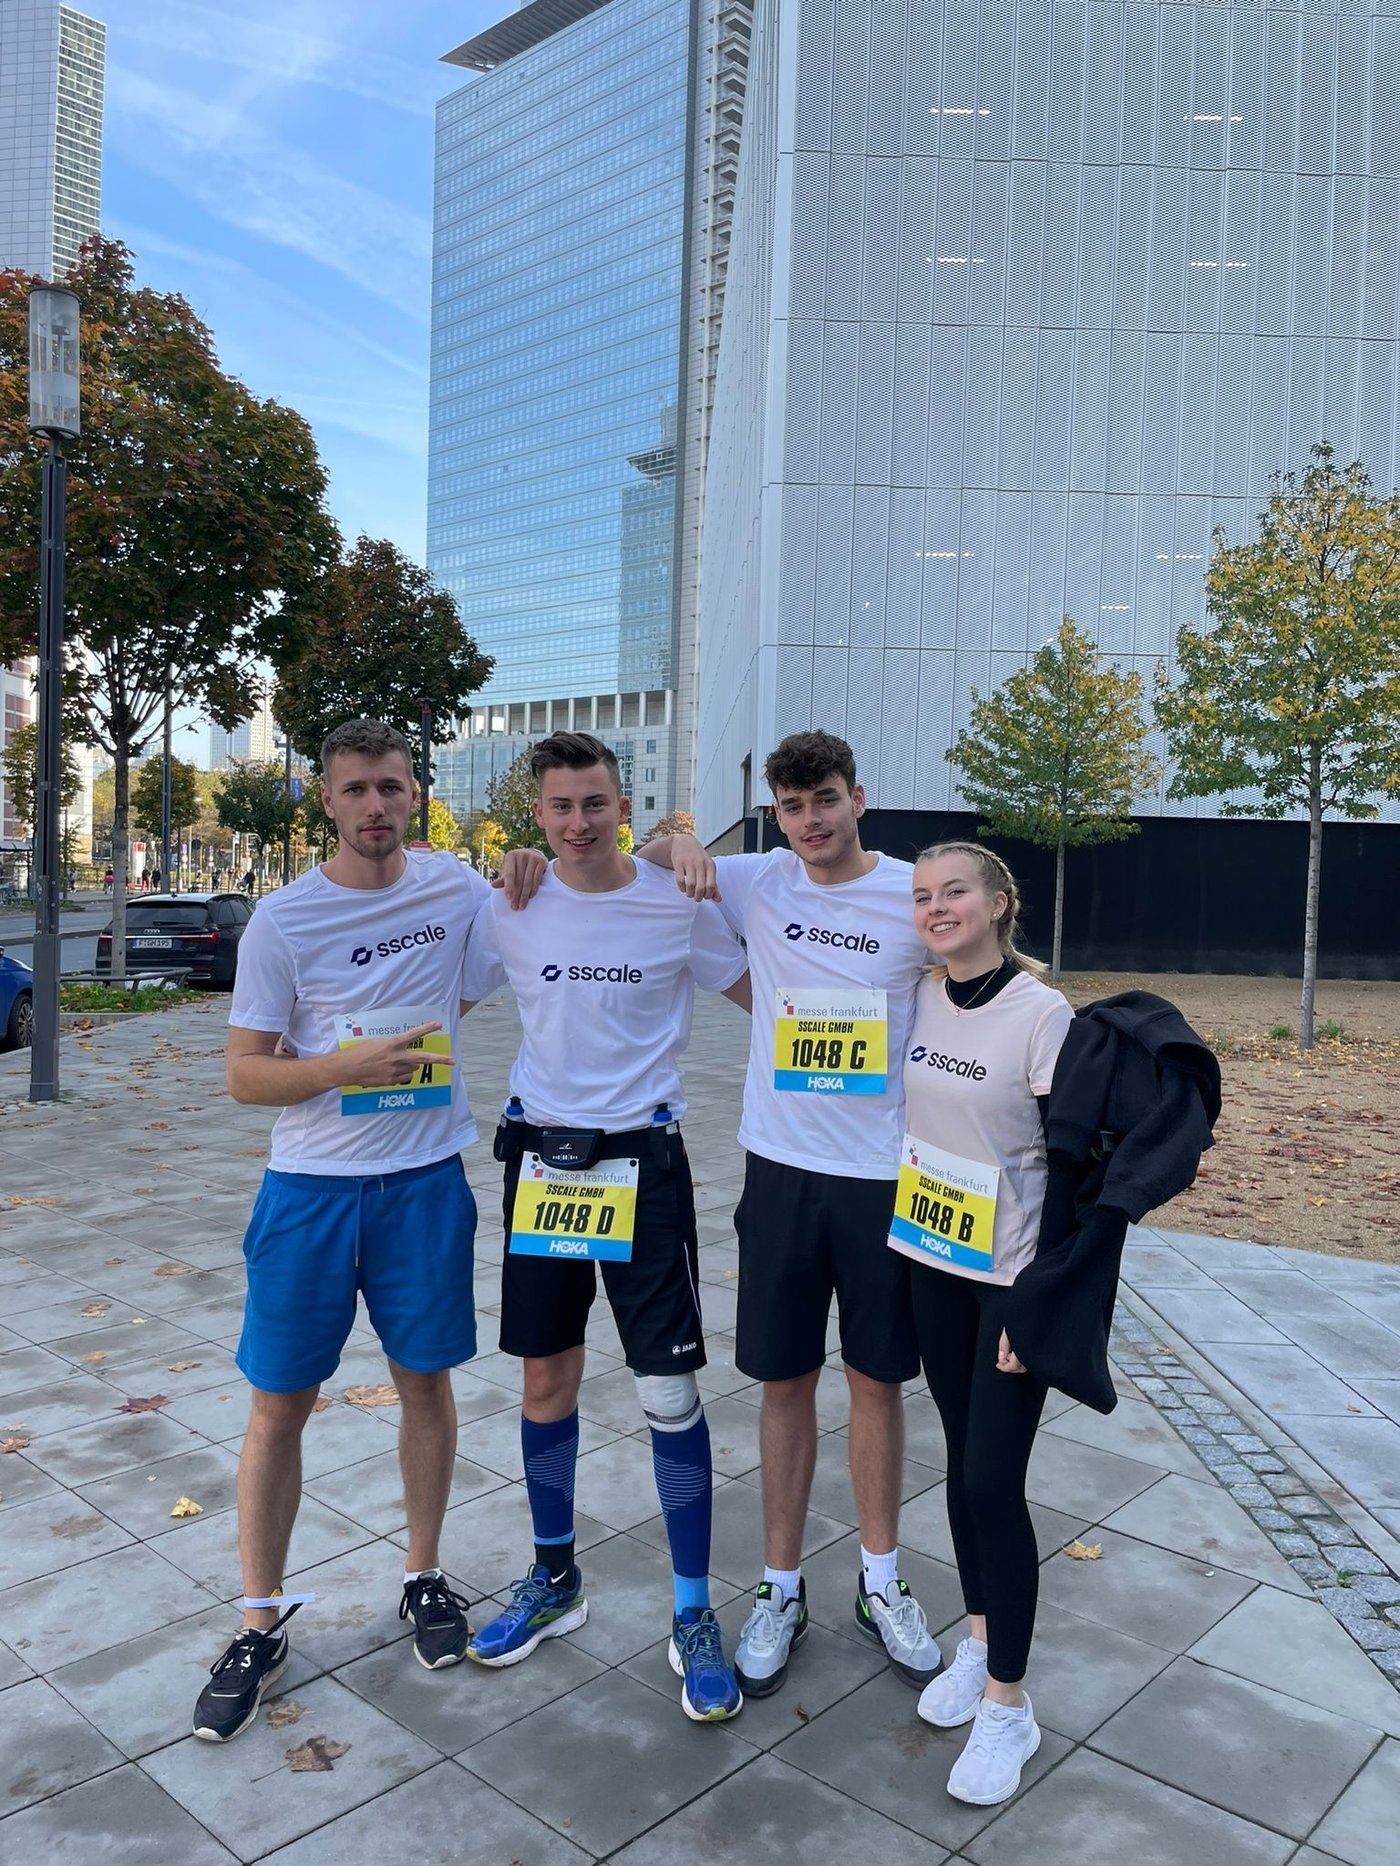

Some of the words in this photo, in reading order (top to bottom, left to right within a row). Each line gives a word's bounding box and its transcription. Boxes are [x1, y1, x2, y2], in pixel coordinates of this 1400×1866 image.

[376, 924, 446, 958] sscale
[806, 927, 880, 955] sscale
[568, 964, 643, 984] sscale
[797, 1008, 828, 1017] messe
[830, 1006, 878, 1017] frankfurt
[368, 1026, 401, 1036] messe
[798, 1021, 826, 1033] SSCALE
[828, 1022, 854, 1033] GMBH
[791, 1038, 843, 1069] 1048
[850, 1040, 867, 1070] C
[420, 1064, 433, 1084] A
[927, 1052, 987, 1082] sscale
[807, 1076, 845, 1090] HOKA
[378, 1093, 415, 1108] HOKA
[548, 1172, 581, 1181] messe
[584, 1172, 629, 1184] frankfurt
[920, 1162, 944, 1178] messe
[946, 1170, 988, 1194] frankfurt
[545, 1184, 578, 1197] SSCALE
[579, 1187, 605, 1199] GMBH
[918, 1176, 942, 1194] SSCALE
[942, 1186, 965, 1204] GMBH
[533, 1201, 592, 1233] 1048
[596, 1206, 615, 1235] D
[909, 1192, 954, 1236] 1048
[957, 1212, 975, 1242] B
[548, 1240, 589, 1255] HOKA
[920, 1234, 952, 1258] HOKA
